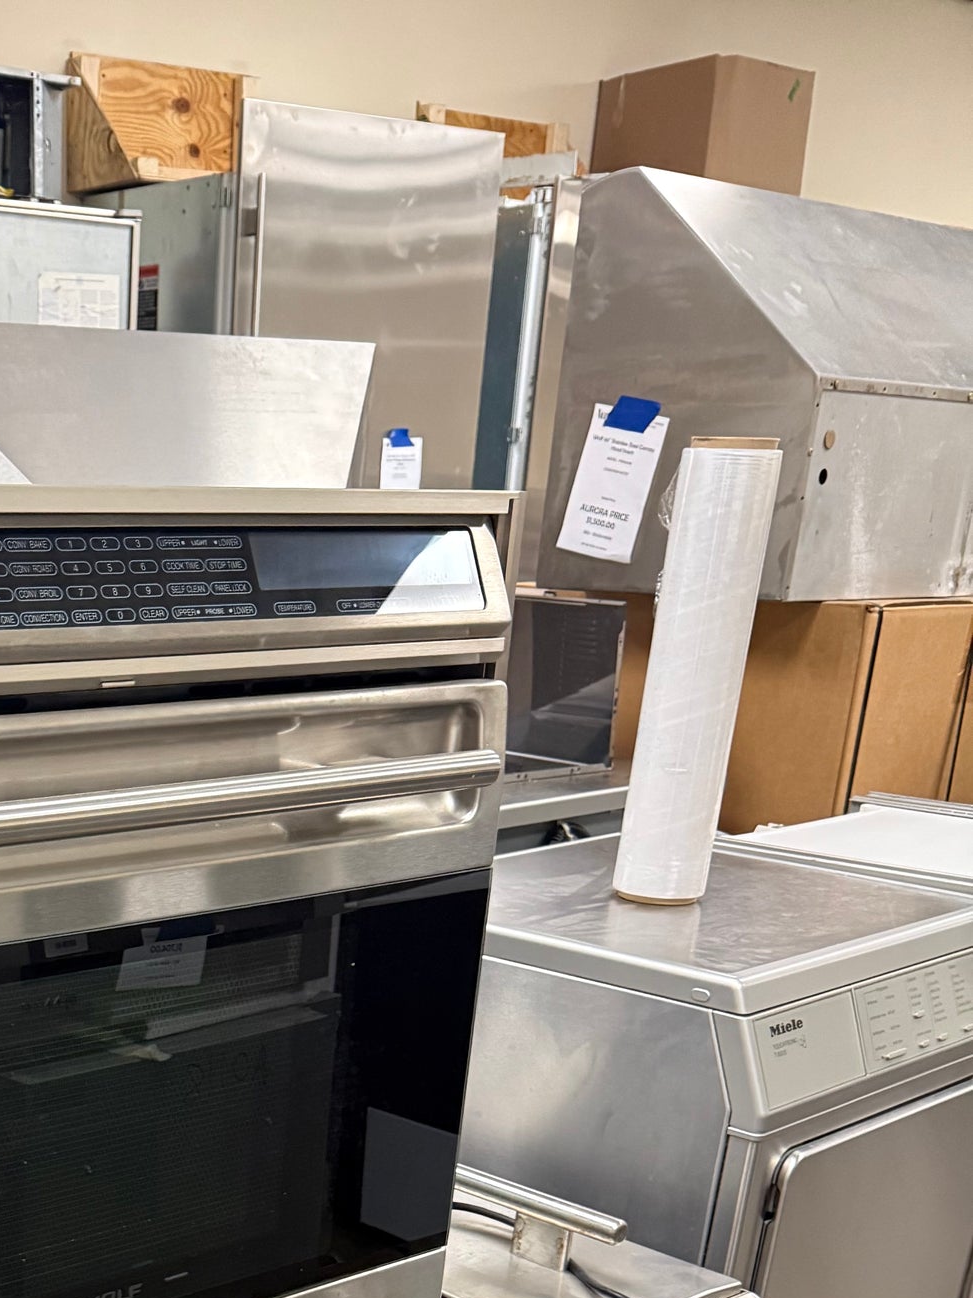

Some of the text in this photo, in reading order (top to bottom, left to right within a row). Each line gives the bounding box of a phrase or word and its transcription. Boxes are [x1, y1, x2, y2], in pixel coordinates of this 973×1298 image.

[609, 510, 630, 522] PRICE
[29, 540, 48, 549] BAKE
[101, 539, 108, 548] 2
[135, 539, 141, 548] 3
[159, 538, 181, 547] UPPER
[217, 538, 239, 547] LOWER
[72, 563, 79, 572] 4
[106, 563, 113, 572] 5
[140, 562, 146, 571] 6
[165, 561, 200, 570] COOK TIME
[208, 560, 243, 569] STOP TIME
[145, 586, 152, 595] 9
[170, 585, 206, 594] SELF CLEAN
[231, 584, 247, 592] LOCK
[39, 588, 60, 598] BROIL
[175, 606, 254, 617] UPPER PROBE LOWER
[277, 603, 313, 612] TEMPERATURE
[24, 613, 65, 624] CONVECTION
[75, 612, 98, 621] ENTER
[117, 611, 124, 619] 0
[141, 610, 165, 619] CLEAR
[769, 1019, 803, 1037] Miele
